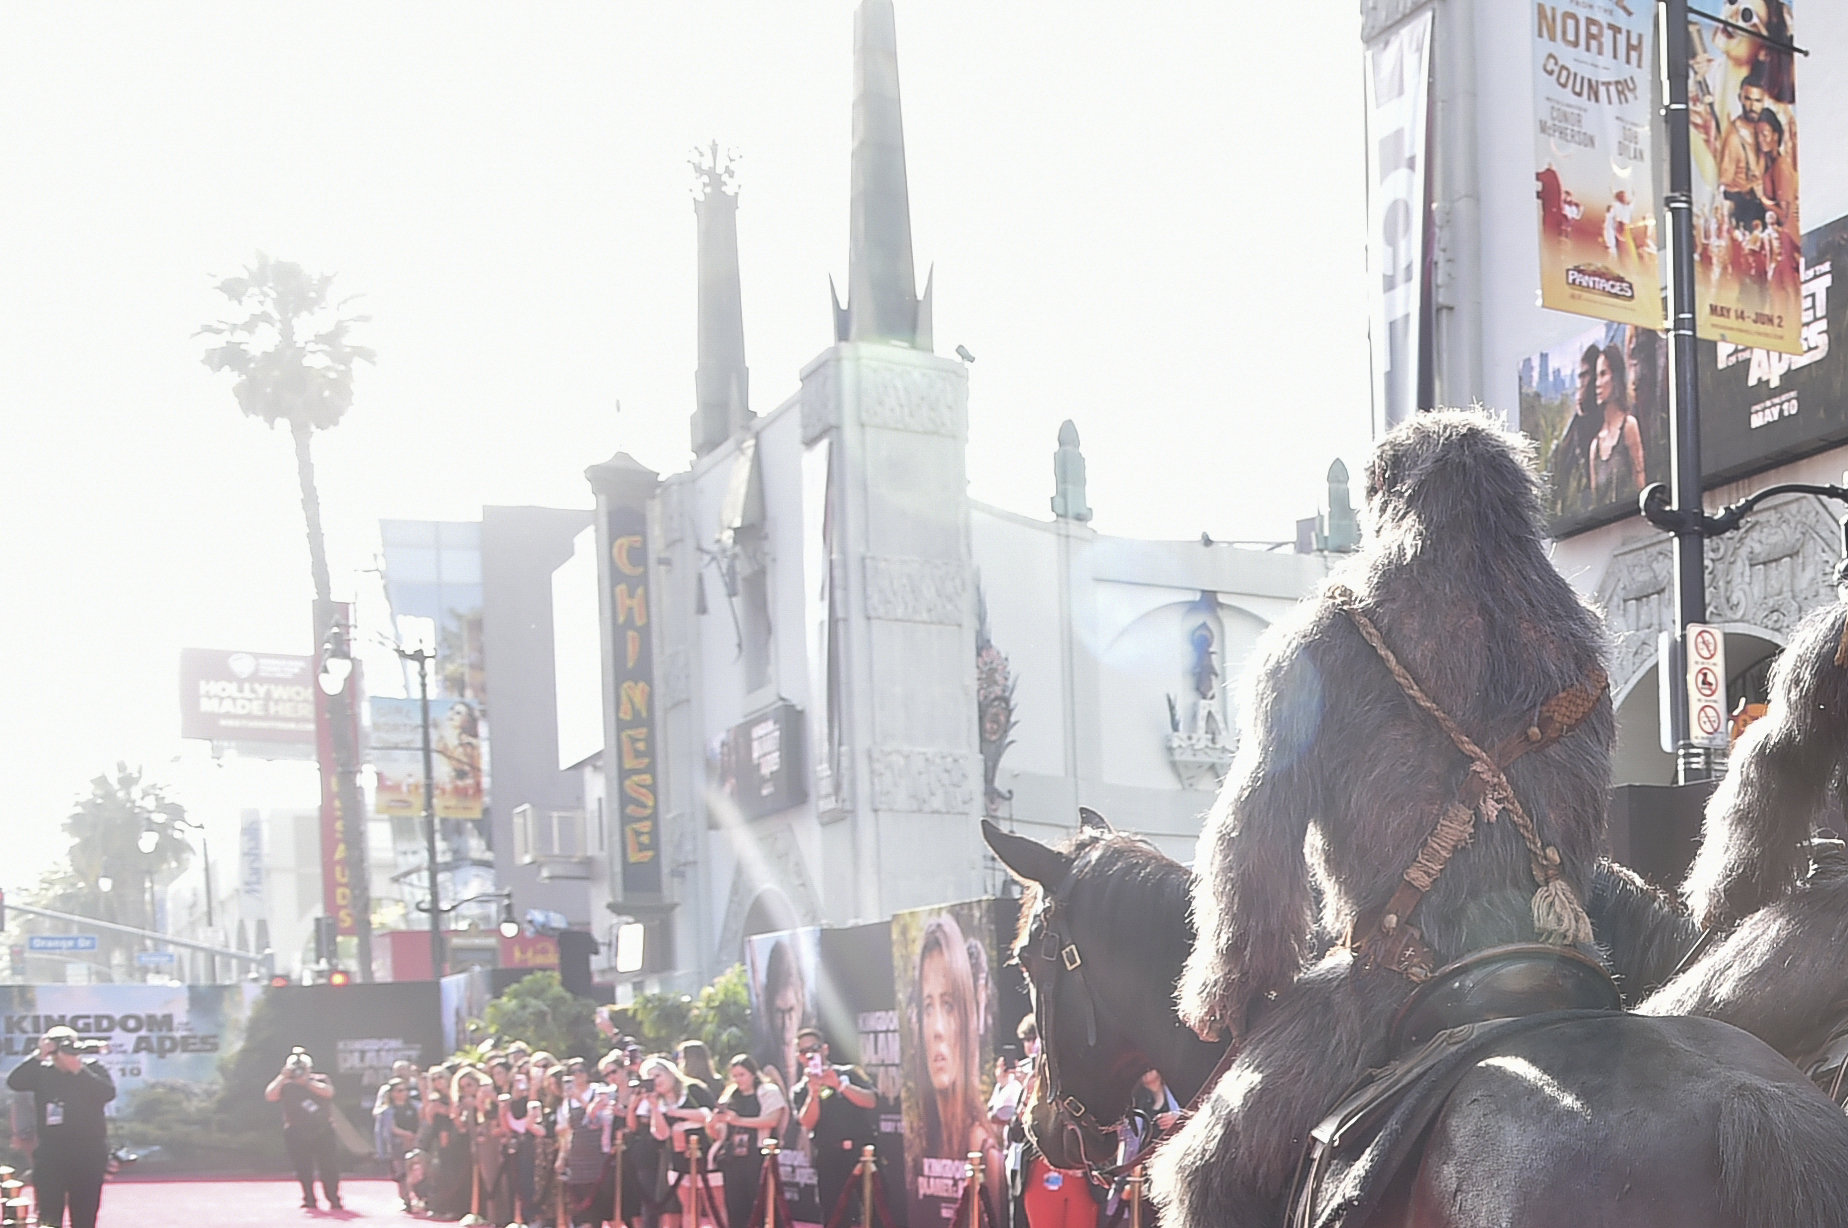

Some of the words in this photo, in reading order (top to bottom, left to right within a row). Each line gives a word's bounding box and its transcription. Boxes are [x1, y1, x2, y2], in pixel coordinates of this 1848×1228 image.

[1537, 2, 1643, 68] NORTH
[1543, 53, 1637, 105] COUNTRY
[1567, 269, 1633, 298] PANTAGES
[1709, 304, 1731, 319] MAY
[1750, 405, 1780, 429] MAY
[1782, 399, 1799, 417] 10
[612, 535, 655, 863] CHINESE
[3, 1013, 174, 1034] KINGDOM
[132, 1034, 220, 1059] APES
